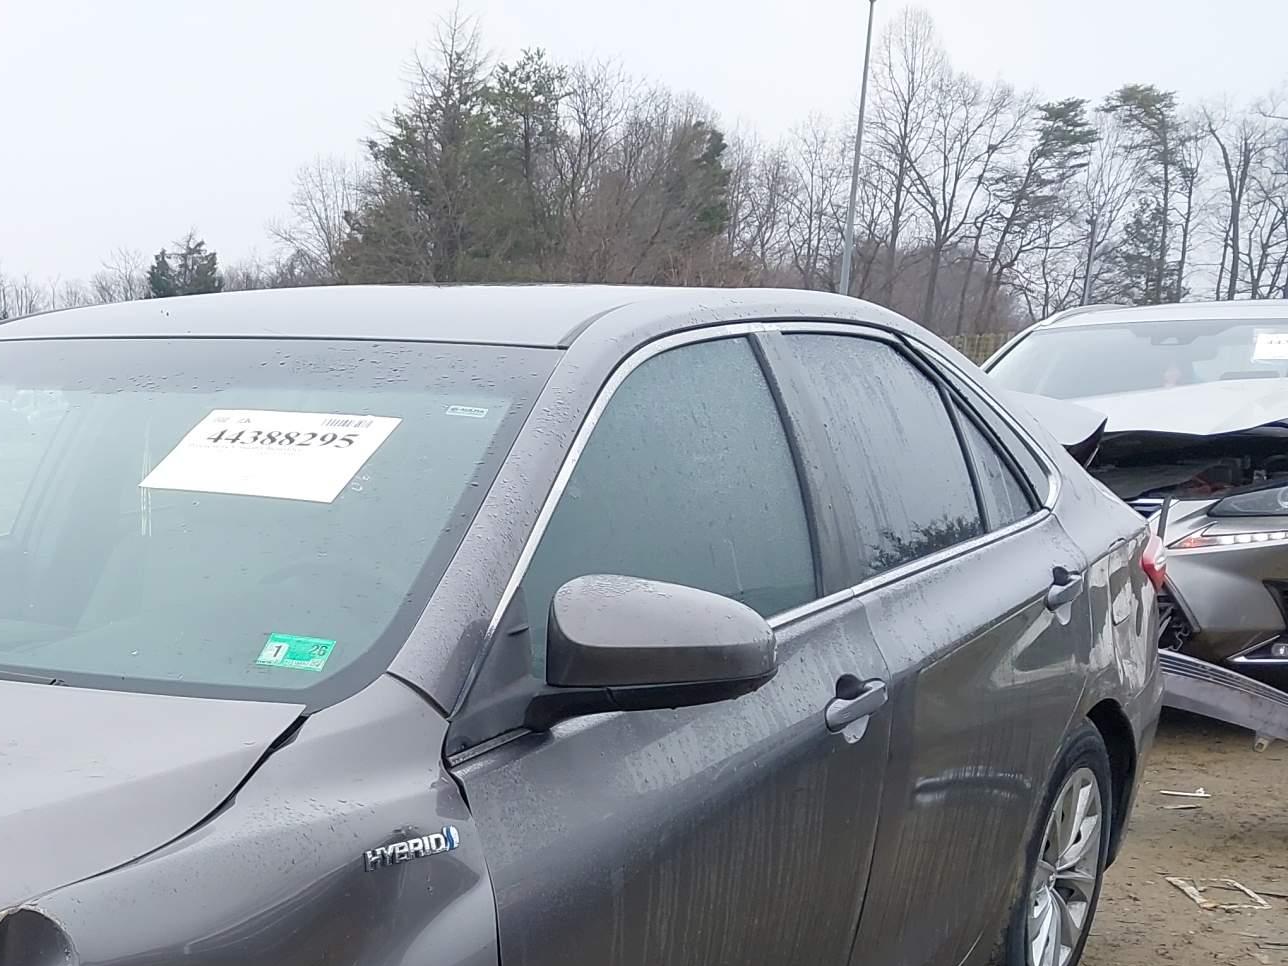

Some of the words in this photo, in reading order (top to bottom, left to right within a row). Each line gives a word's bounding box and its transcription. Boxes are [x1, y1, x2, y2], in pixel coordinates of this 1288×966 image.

[207, 428, 361, 449] 44388295
[273, 645, 282, 657] 1
[364, 833, 449, 872] HYBRID
